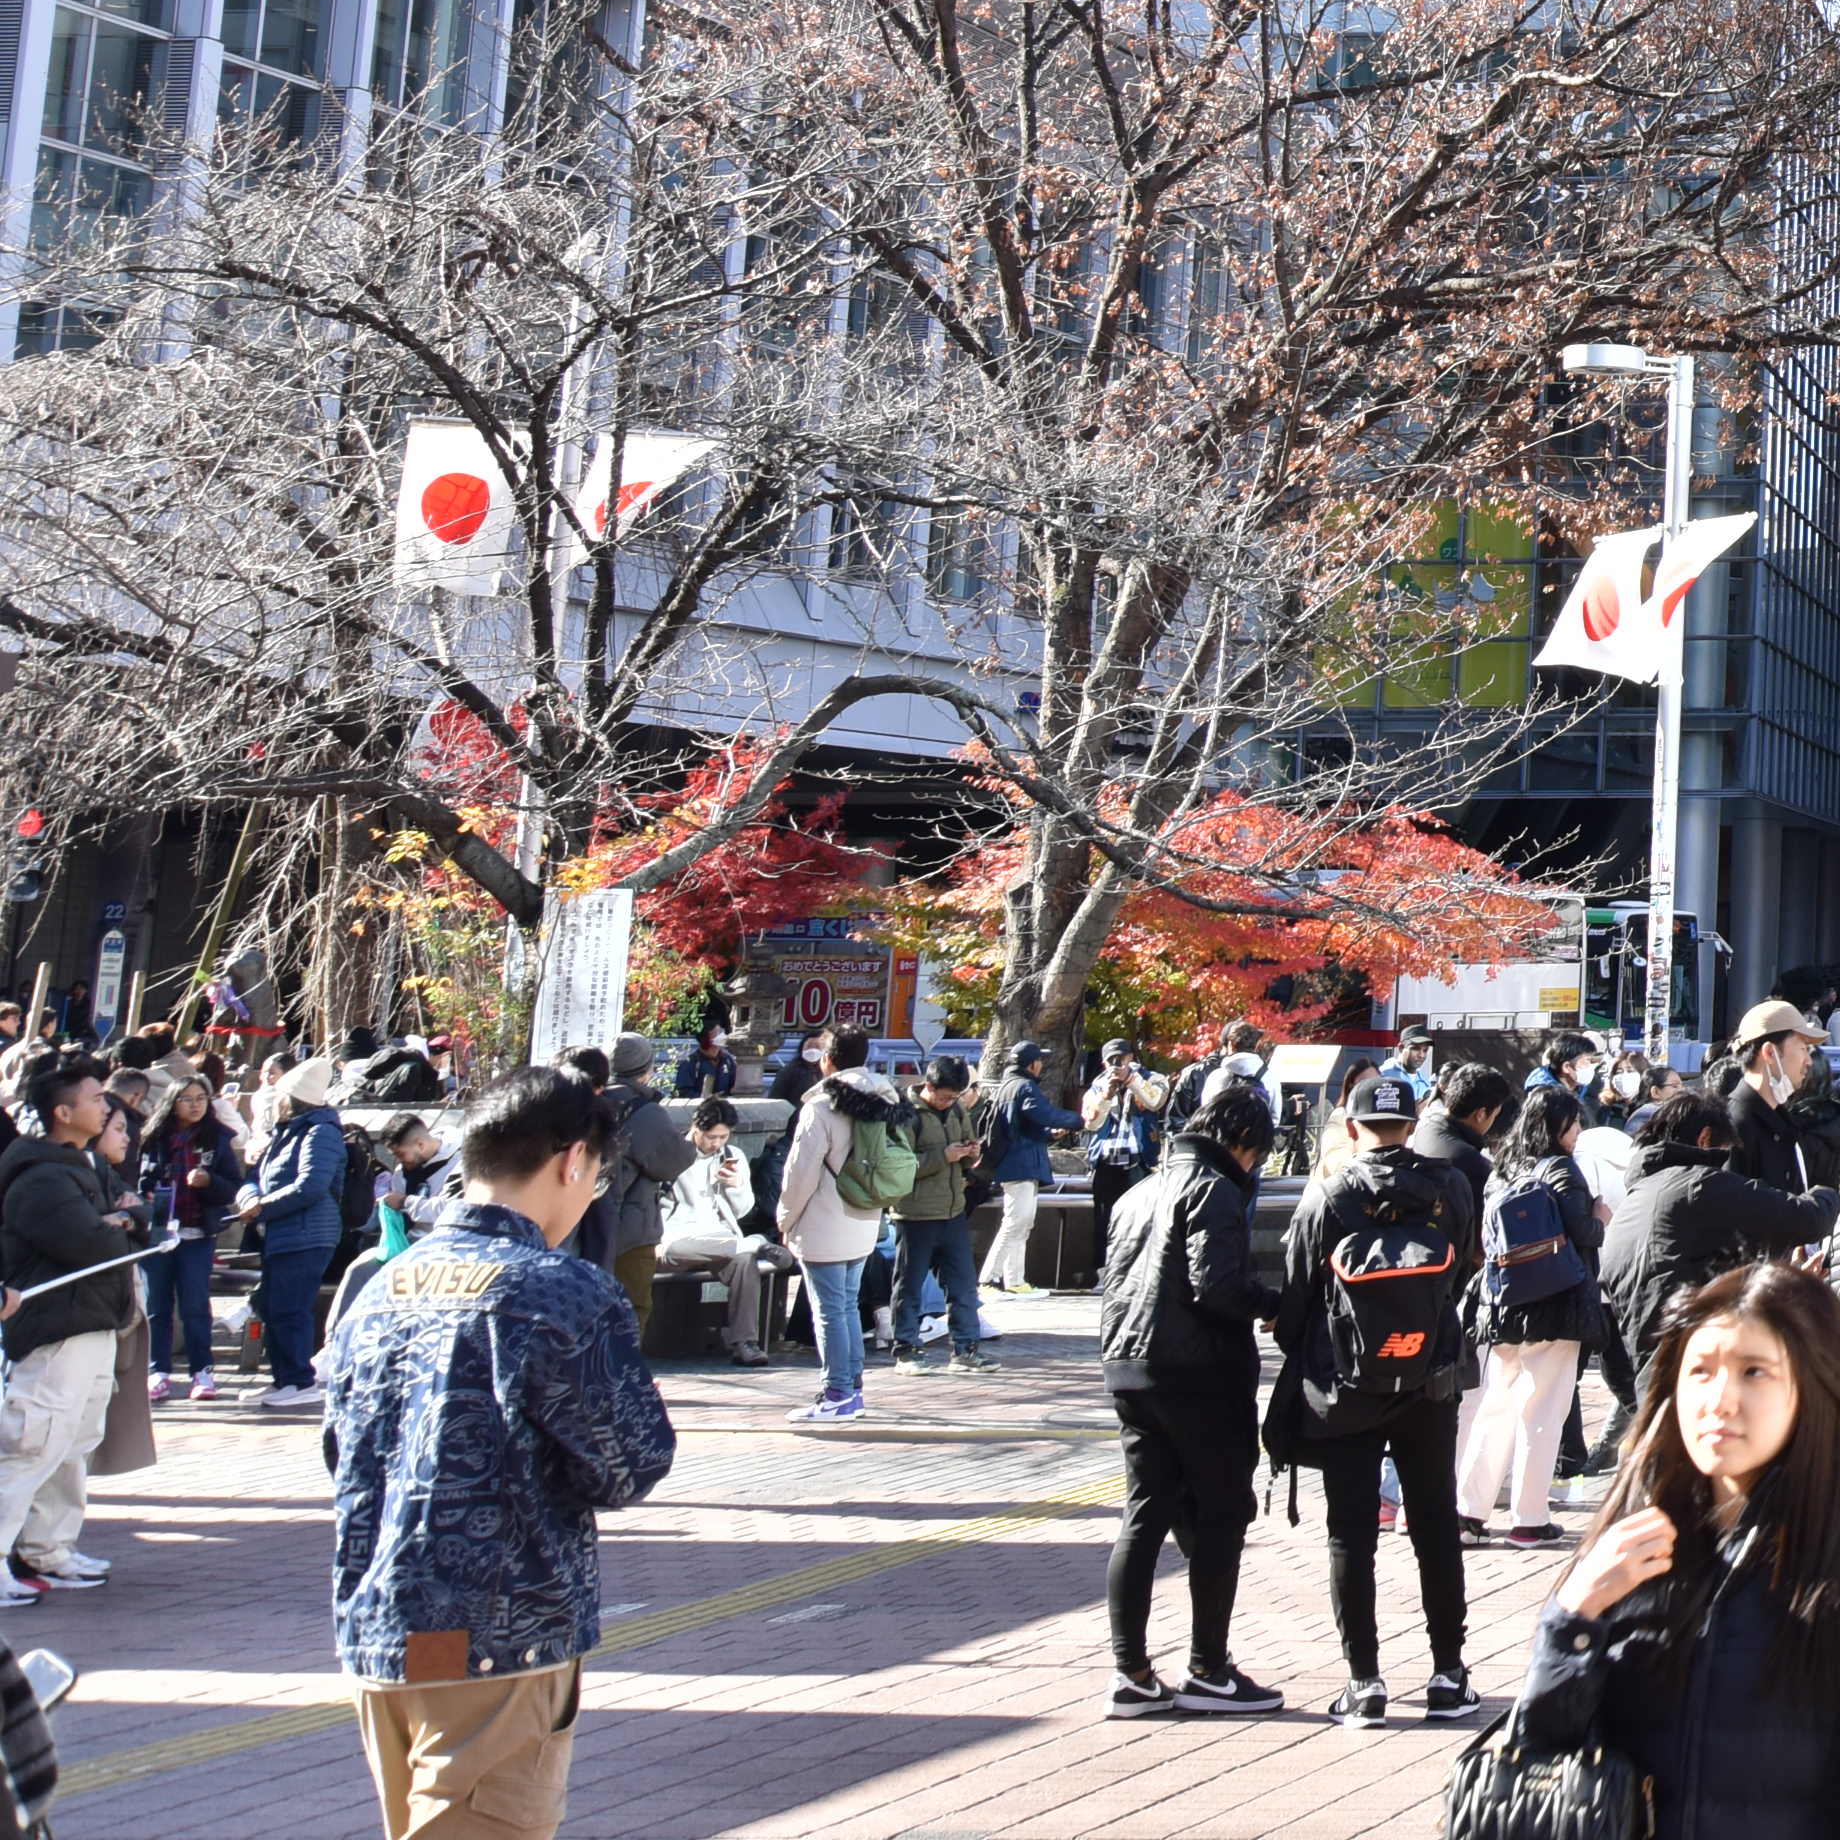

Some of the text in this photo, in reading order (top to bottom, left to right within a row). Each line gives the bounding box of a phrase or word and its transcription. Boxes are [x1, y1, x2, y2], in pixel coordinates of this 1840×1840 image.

[104, 904, 125, 920] 22
[781, 960, 883, 974] おめでとうございます
[389, 1264, 503, 1300] EVISU
